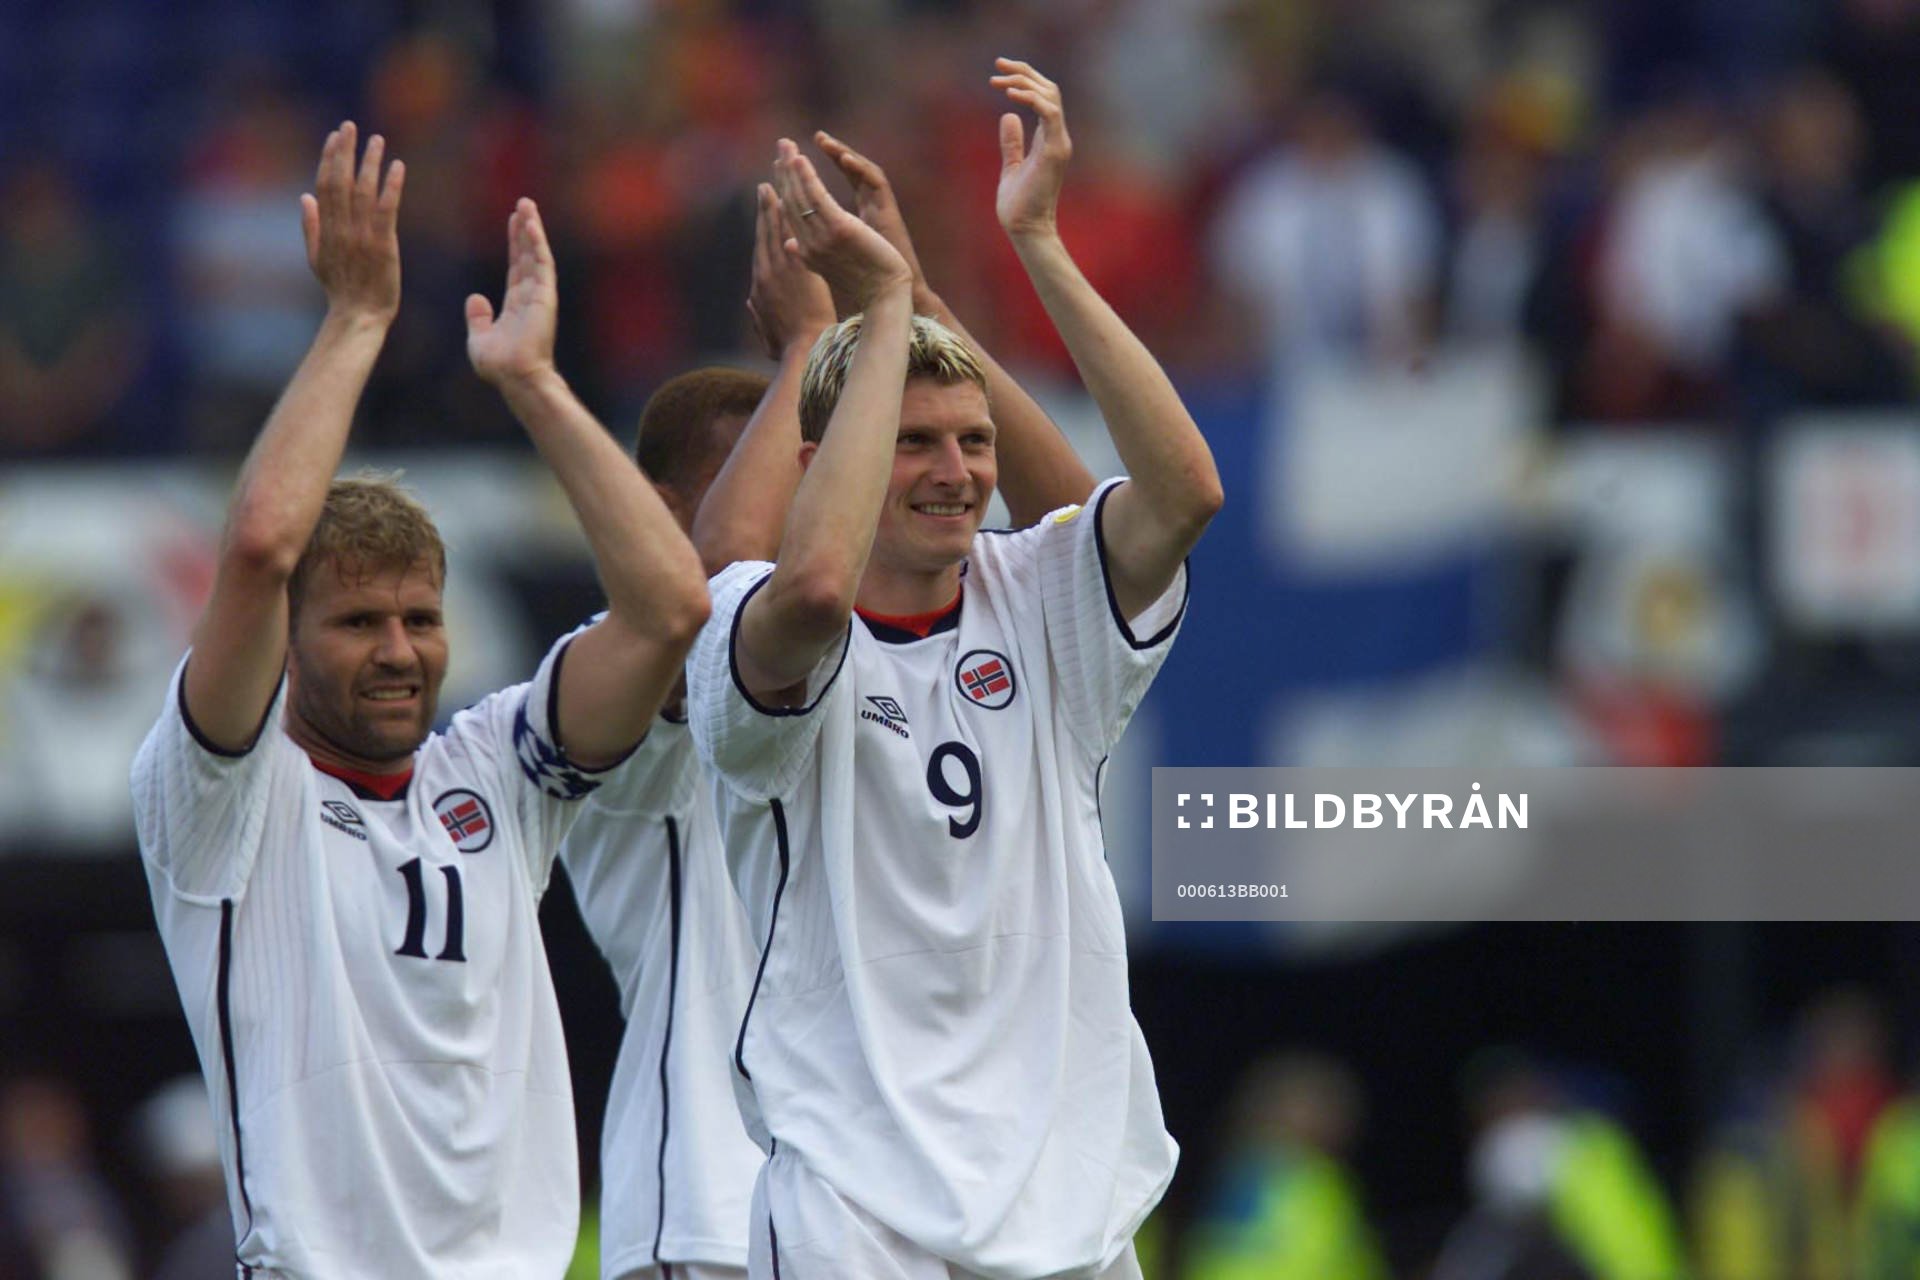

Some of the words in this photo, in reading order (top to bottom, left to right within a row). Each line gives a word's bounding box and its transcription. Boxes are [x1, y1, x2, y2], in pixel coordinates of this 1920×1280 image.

[861, 710, 909, 738] UMBRO
[927, 741, 982, 839] 9
[394, 857, 467, 962] 11
